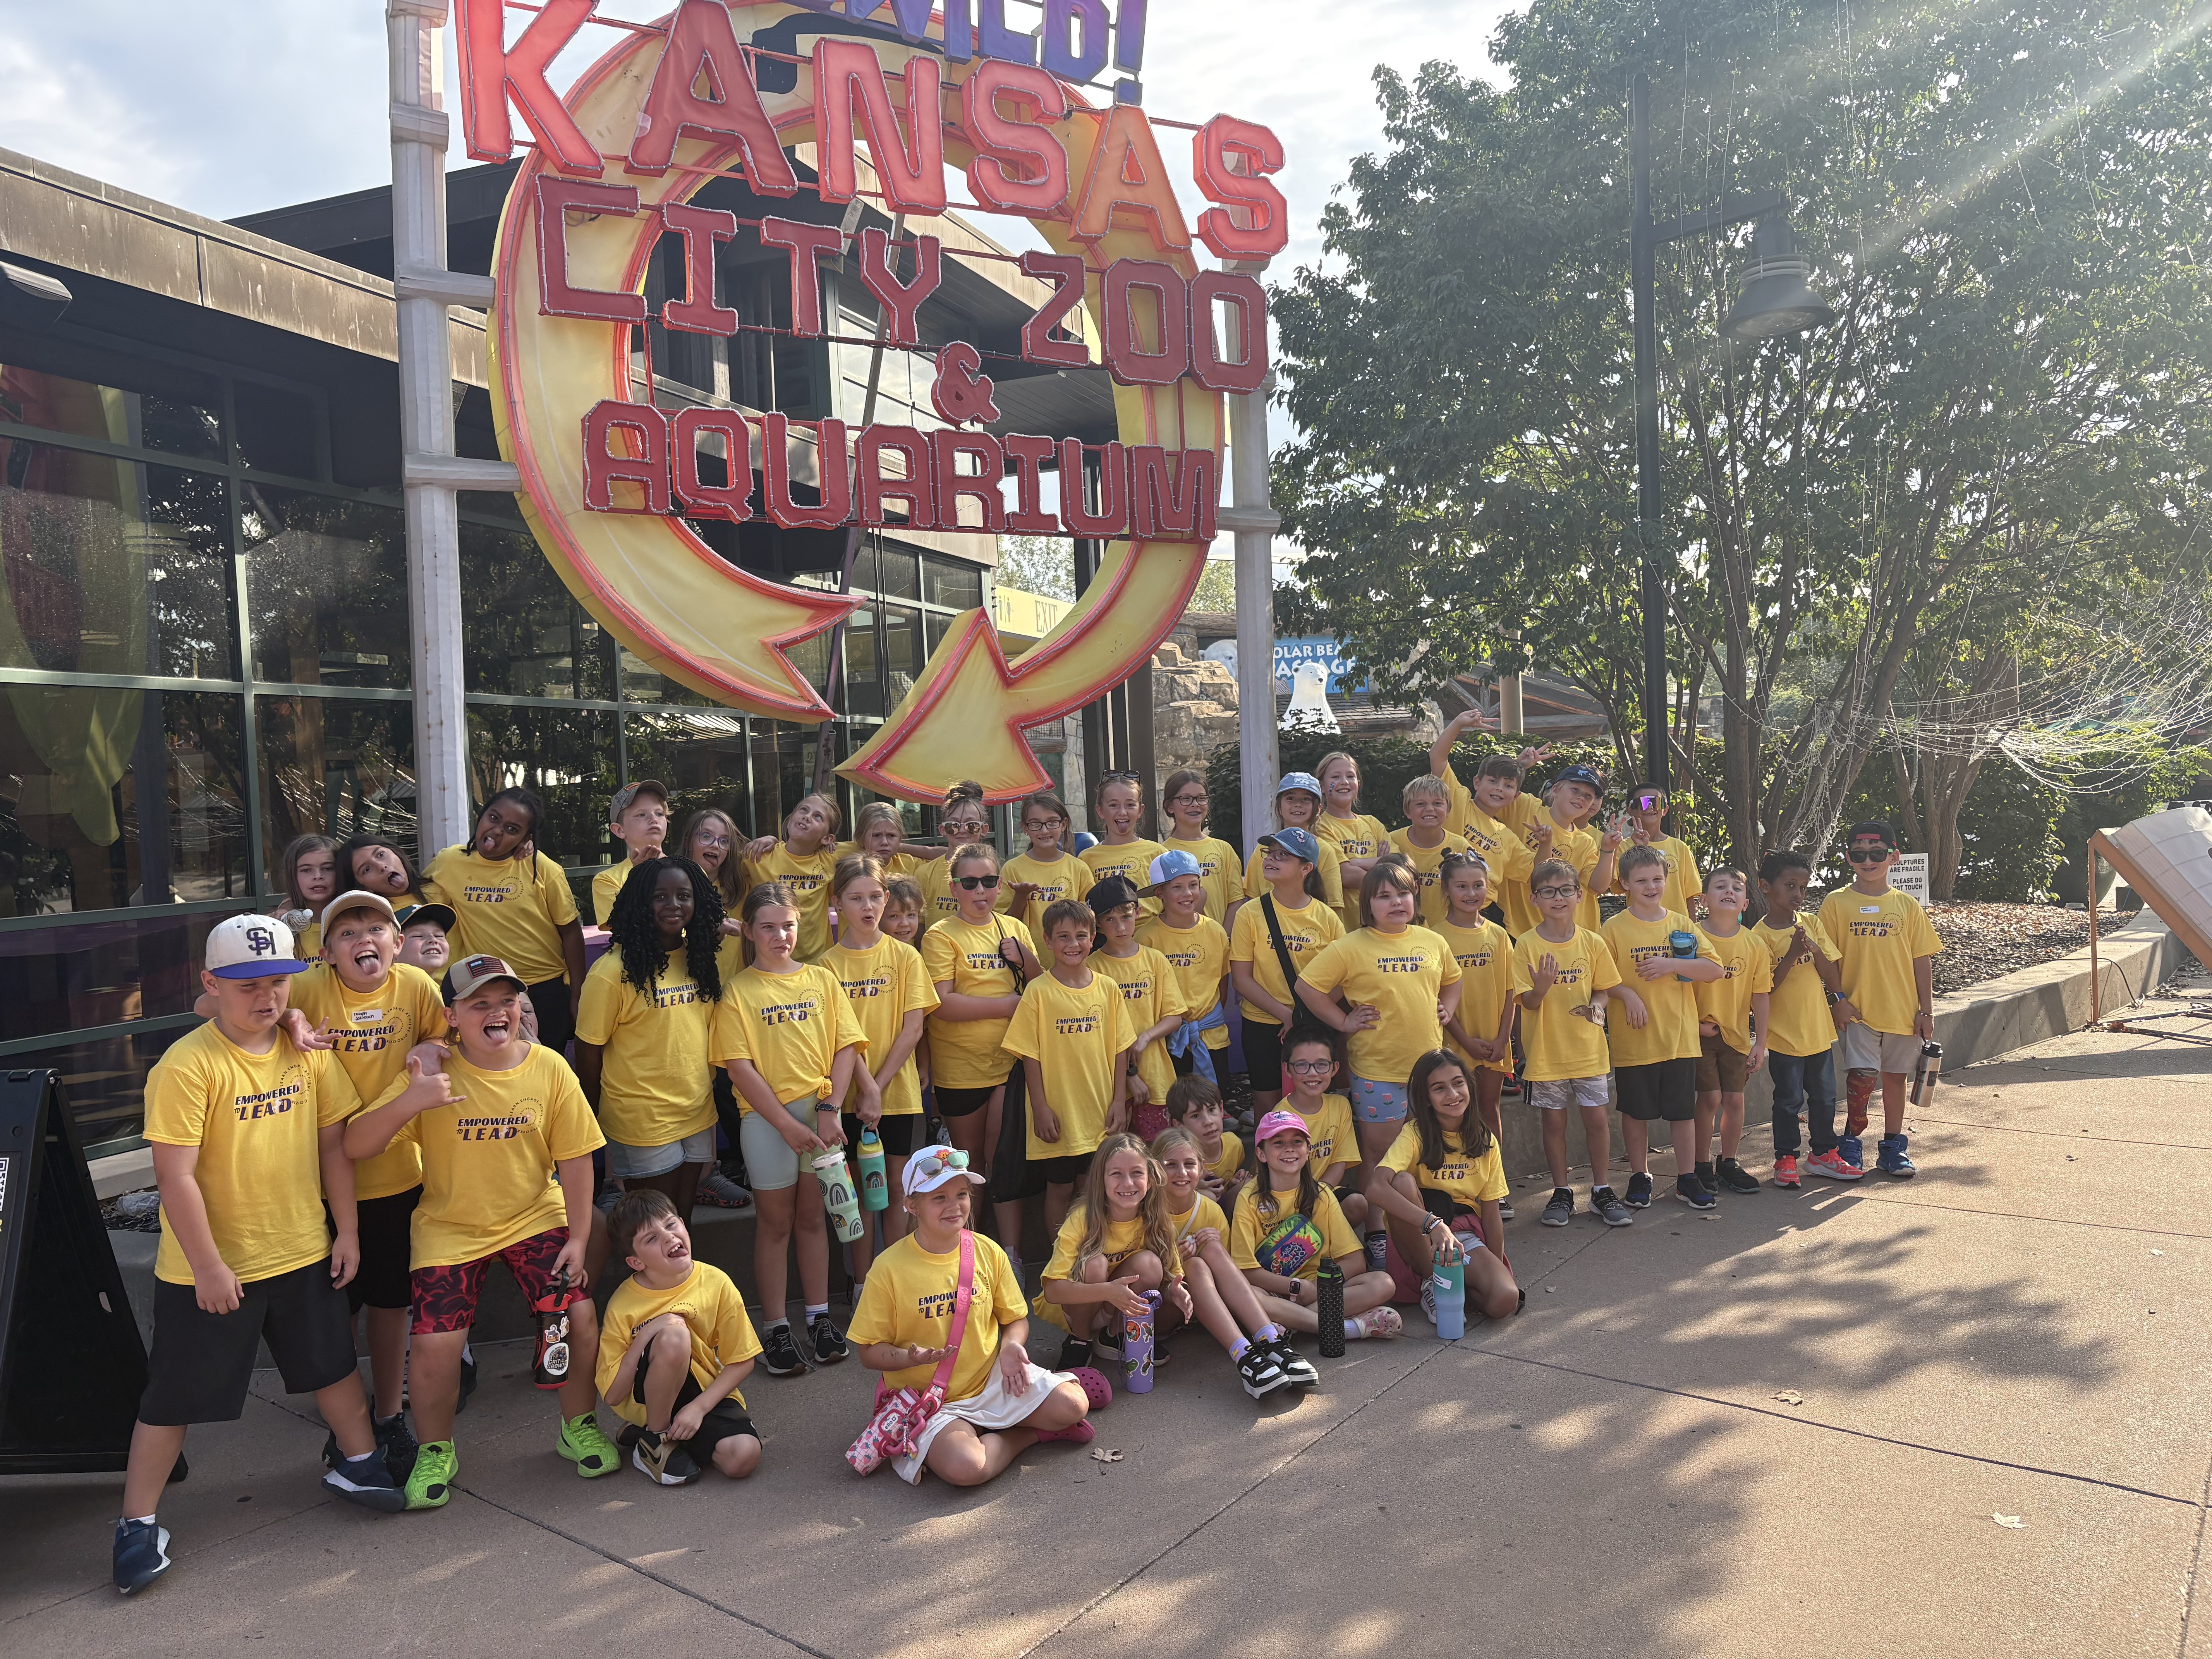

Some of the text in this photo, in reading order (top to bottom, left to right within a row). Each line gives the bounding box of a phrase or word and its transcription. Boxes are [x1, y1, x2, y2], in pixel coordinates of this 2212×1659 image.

[454, 0, 1289, 260] KANSAS
[534, 171, 1269, 396] CITY ZOO
[931, 340, 1002, 429] &
[582, 398, 1219, 543] AQUARIUM
[1034, 600, 1058, 634] EXIT
[1274, 644, 1342, 659] OLAR BEA
[1463, 830, 1490, 851] LEAD
[1465, 824, 1497, 847] EMPOWERED
[1095, 864, 1131, 874] EMPOWERED
[786, 881, 817, 890] EAD
[467, 893, 503, 903] LEAD
[1030, 892, 1056, 902] EAD
[939, 902, 958, 911] LEA
[1854, 927, 1887, 937] LEAD
[1267, 934, 1310, 943] EOWERED
[972, 959, 1006, 969] LEAD
[1169, 958, 1191, 967] EAD
[1377, 956, 1424, 964] EMPOWERED
[1383, 963, 1419, 973] LEAD
[840, 978, 886, 988] MPOWERED
[1554, 975, 1577, 984] EAD
[1119, 982, 1148, 990] OWERED
[848, 986, 879, 999] EAD
[1123, 989, 1142, 1000] AD
[660, 992, 695, 1008] LEAD
[761, 1001, 814, 1015] EMPOWERED
[768, 1010, 808, 1026] LEAD
[1056, 1015, 1097, 1025] EMPOWERED
[1060, 1023, 1092, 1034] LEAD
[332, 1037, 387, 1052] LEAD
[235, 1084, 300, 1106] EMPOWERED
[239, 1098, 292, 1121] LEAD
[457, 1116, 528, 1127] EMPOWERED
[462, 1127, 518, 1141] LEAD
[1433, 1170, 1464, 1180] LEAD
[918, 1287, 977, 1306] EMPOWD
[925, 1301, 955, 1319] LEA
[884, 1420, 893, 1430] ello
